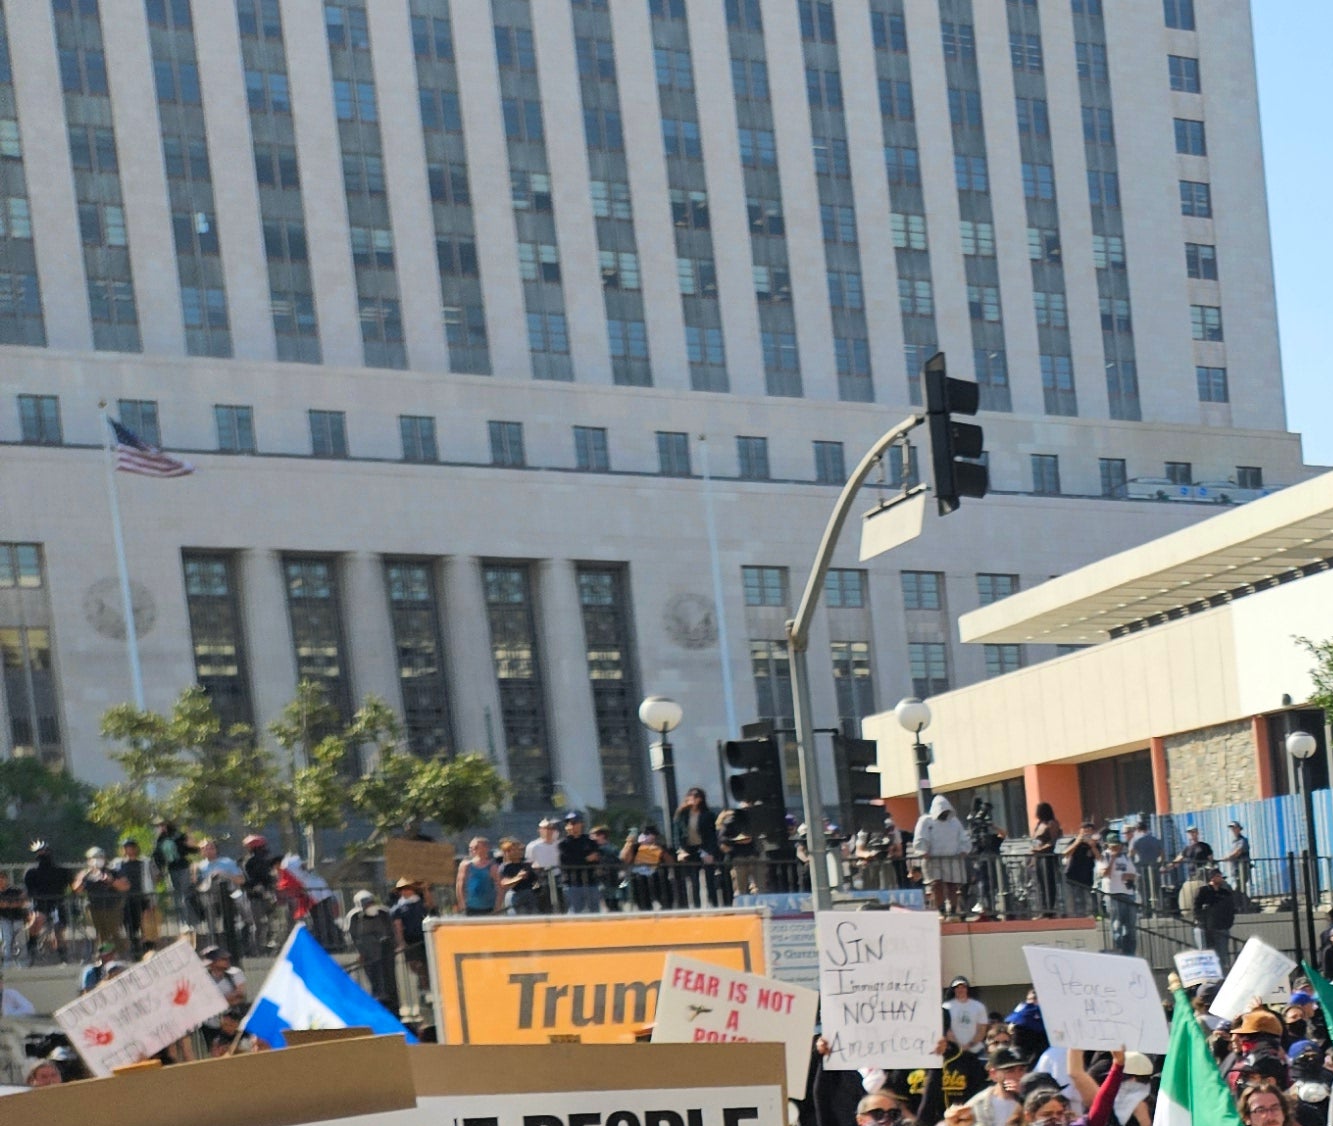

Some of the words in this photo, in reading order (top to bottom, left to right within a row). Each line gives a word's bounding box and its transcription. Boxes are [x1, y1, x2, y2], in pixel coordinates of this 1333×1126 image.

[826, 921, 884, 966] SIN
[508, 973, 663, 1030] Trum
[672, 967, 720, 997] FEAR
[729, 981, 748, 1005] IS
[757, 987, 796, 1015] NOT
[844, 1002, 873, 1025] NO
[725, 1010, 741, 1032] A
